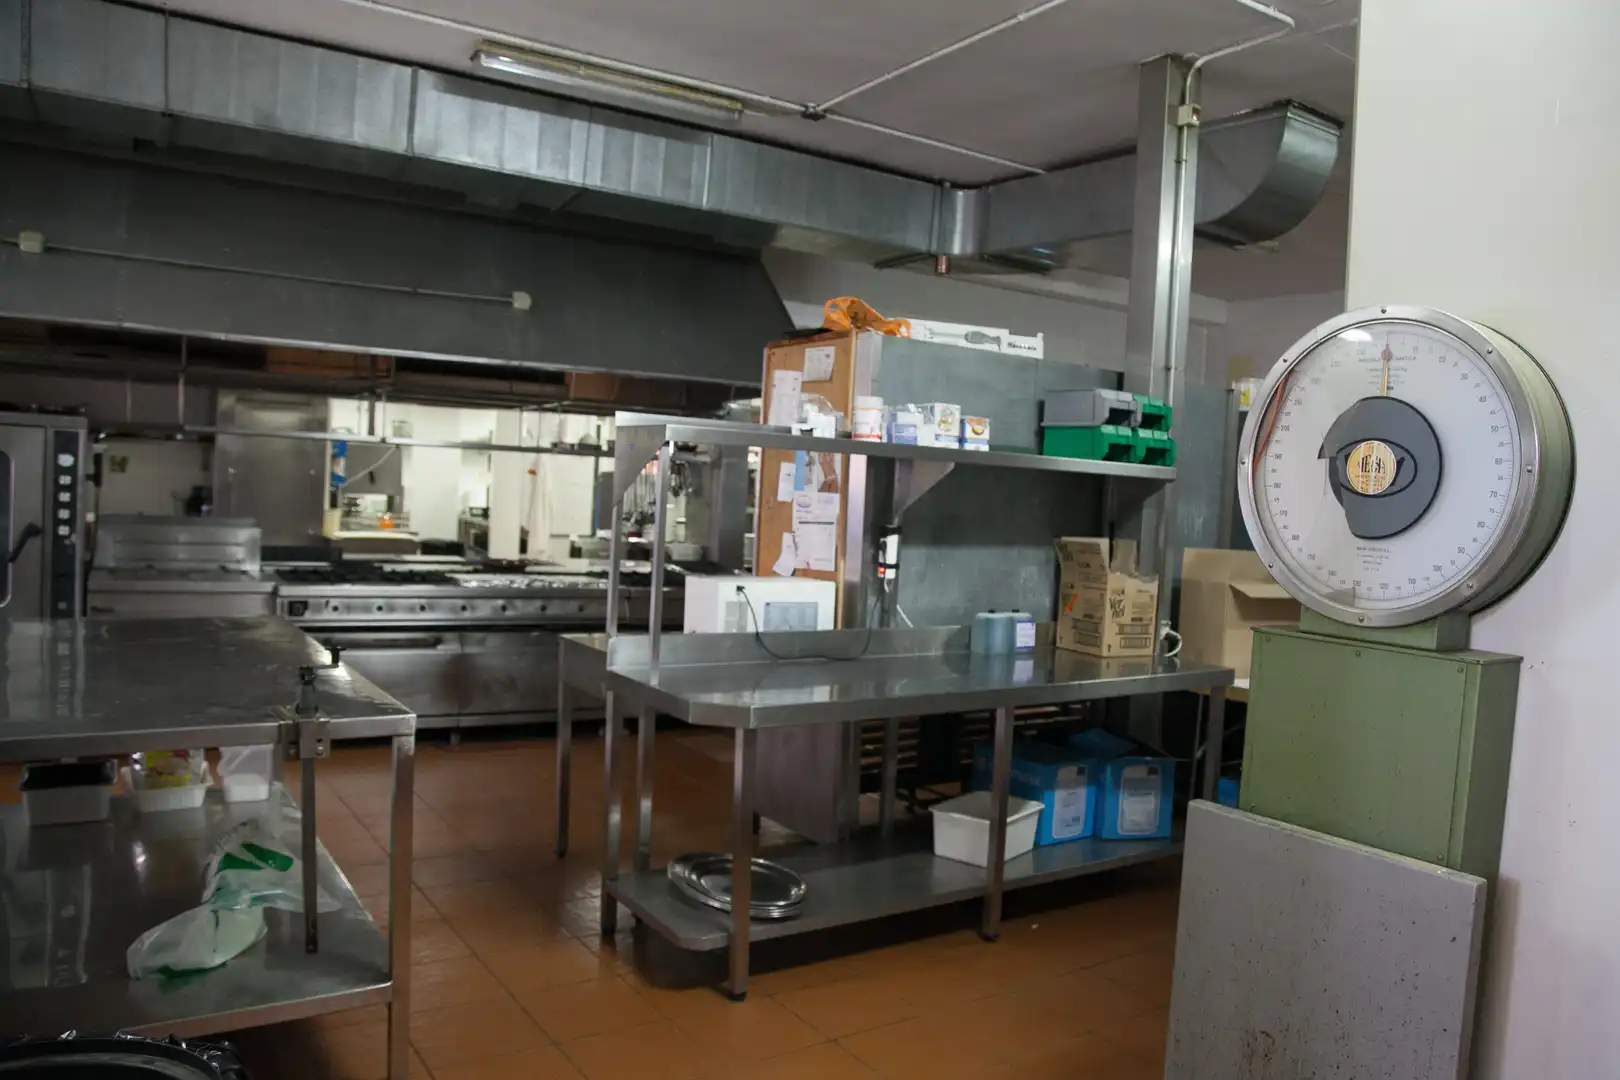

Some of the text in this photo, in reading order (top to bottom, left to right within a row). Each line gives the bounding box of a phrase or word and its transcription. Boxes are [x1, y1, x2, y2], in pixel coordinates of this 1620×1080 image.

[1460, 373, 1469, 381] 30
[1490, 425, 1499, 433] 50
[1488, 490, 1498, 498] 70
[1407, 577, 1417, 585] 110
